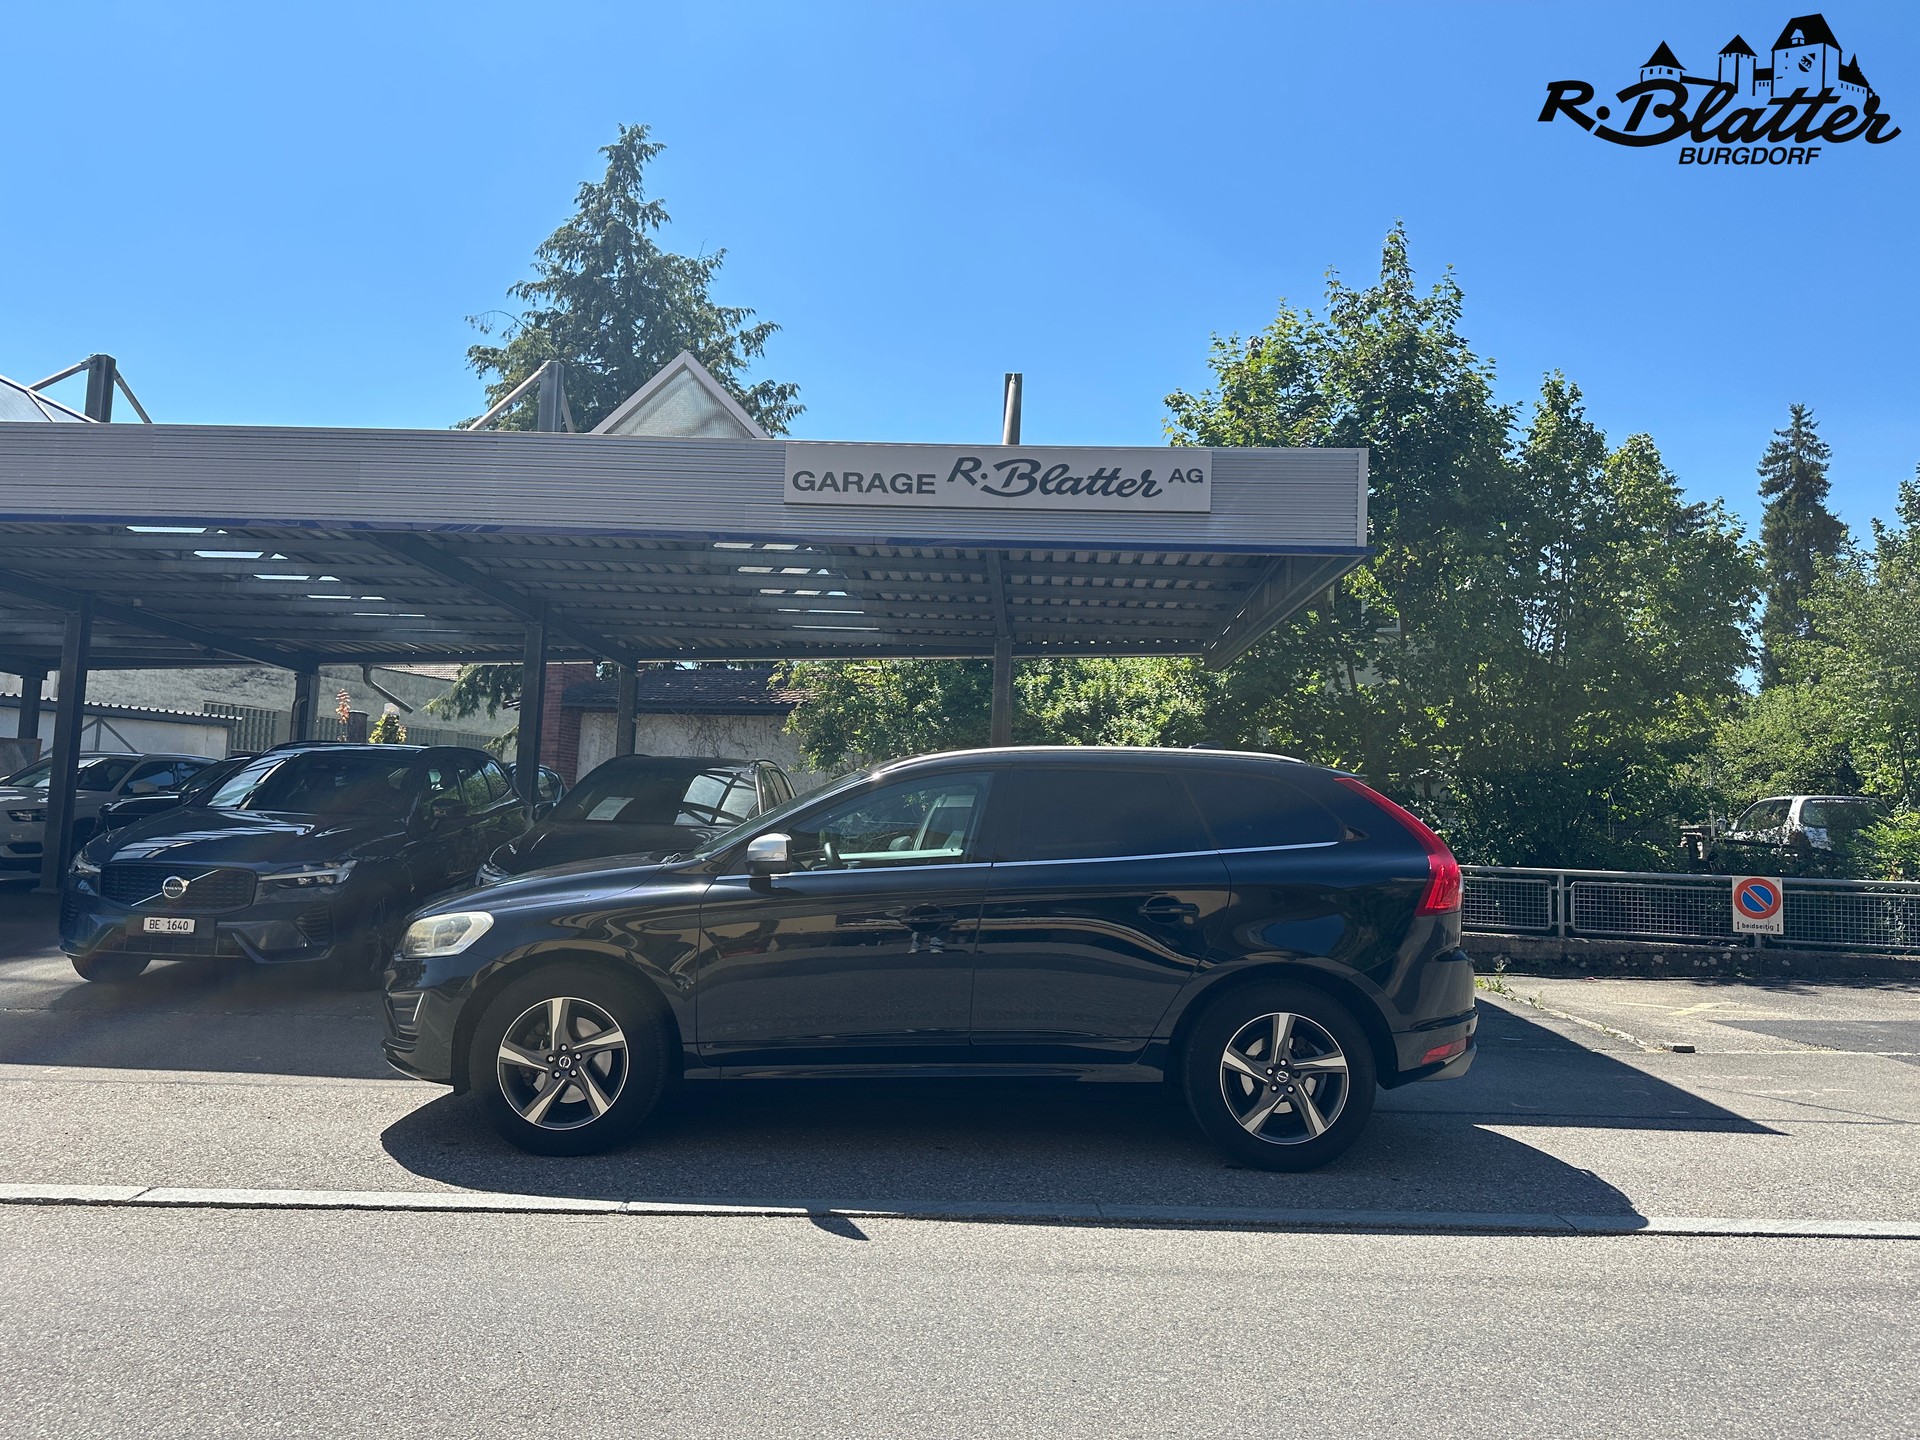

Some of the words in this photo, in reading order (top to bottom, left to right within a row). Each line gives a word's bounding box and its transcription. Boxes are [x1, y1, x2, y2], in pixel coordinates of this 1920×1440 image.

[792, 470, 936, 495] GARAGE
[1169, 468, 1204, 484] AG
[149, 919, 161, 930] BE
[166, 920, 189, 931] 1640
[1741, 922, 1774, 931] beidseitig
